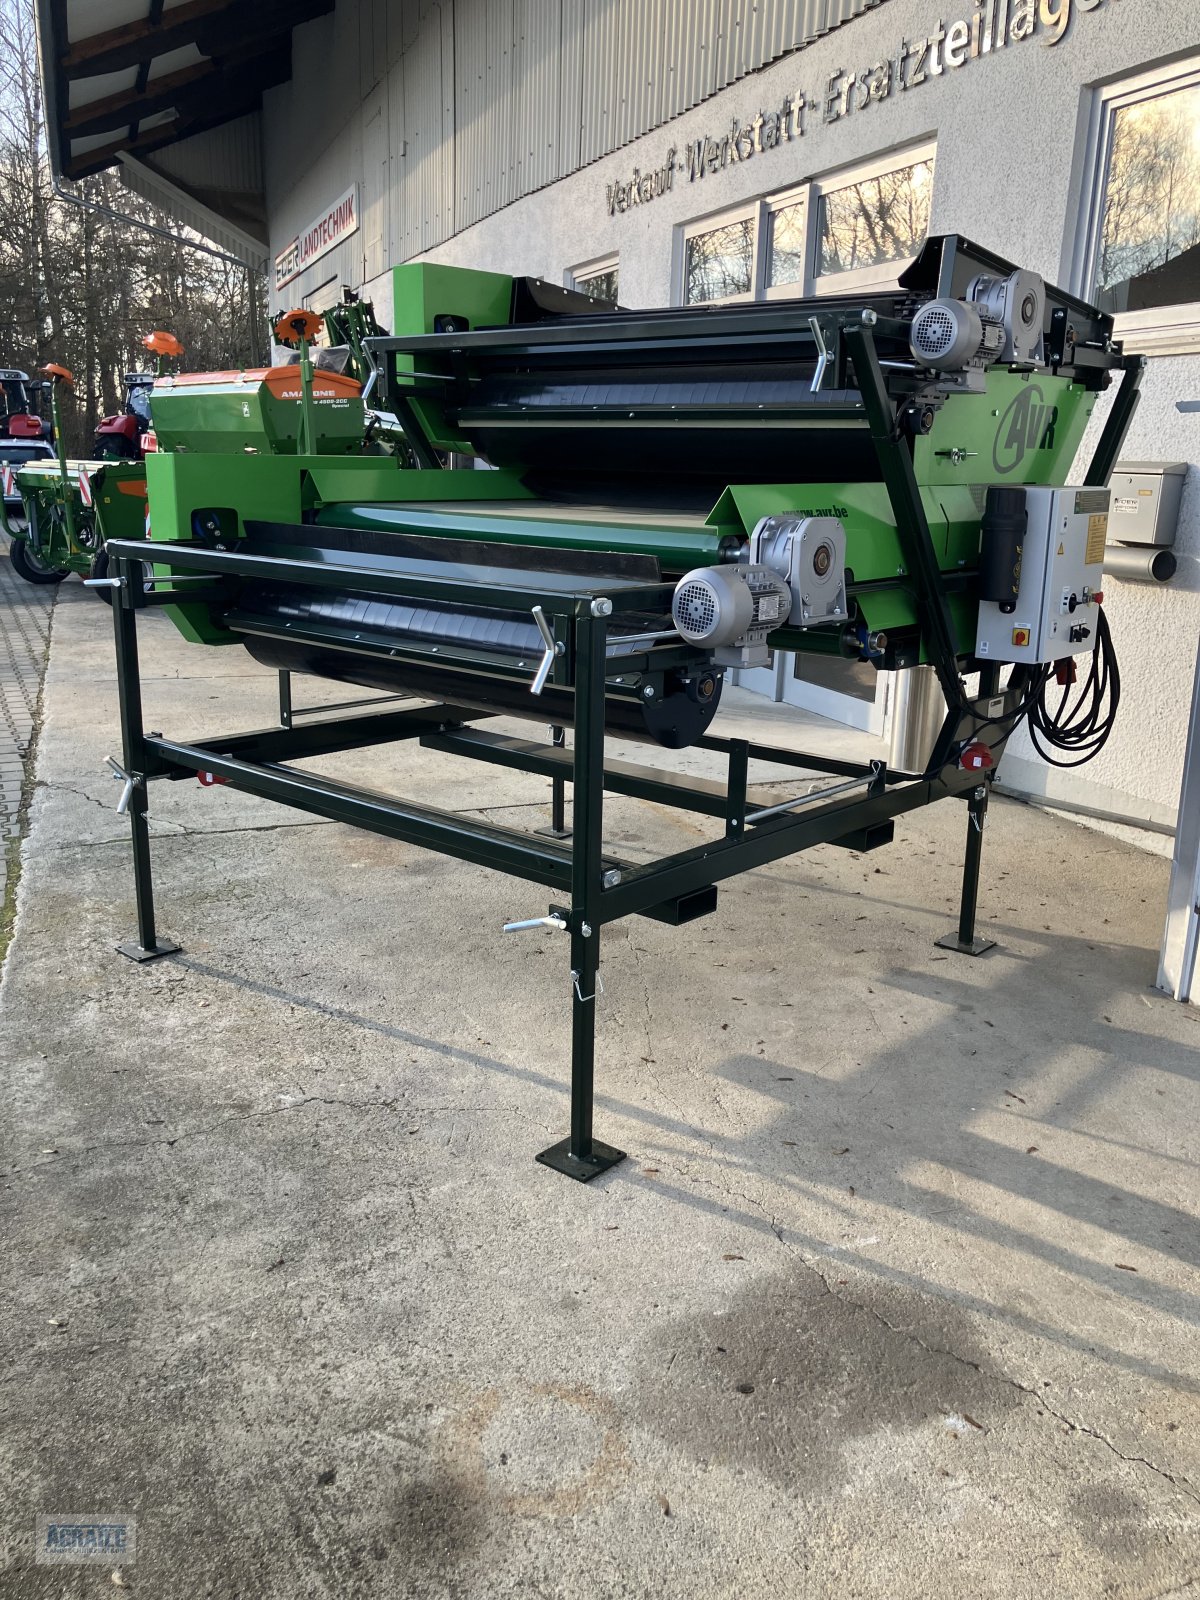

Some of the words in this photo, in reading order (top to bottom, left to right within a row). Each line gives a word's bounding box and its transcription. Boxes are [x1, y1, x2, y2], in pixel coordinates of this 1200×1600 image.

[606, 143, 677, 216] Verkauf
[685, 88, 804, 182] Werkstatt
[823, 0, 1102, 125] Ersatzteillag
[276, 245, 299, 283] EDER
[300, 193, 355, 263] LANDTECHNIK
[995, 385, 1059, 466] AVR
